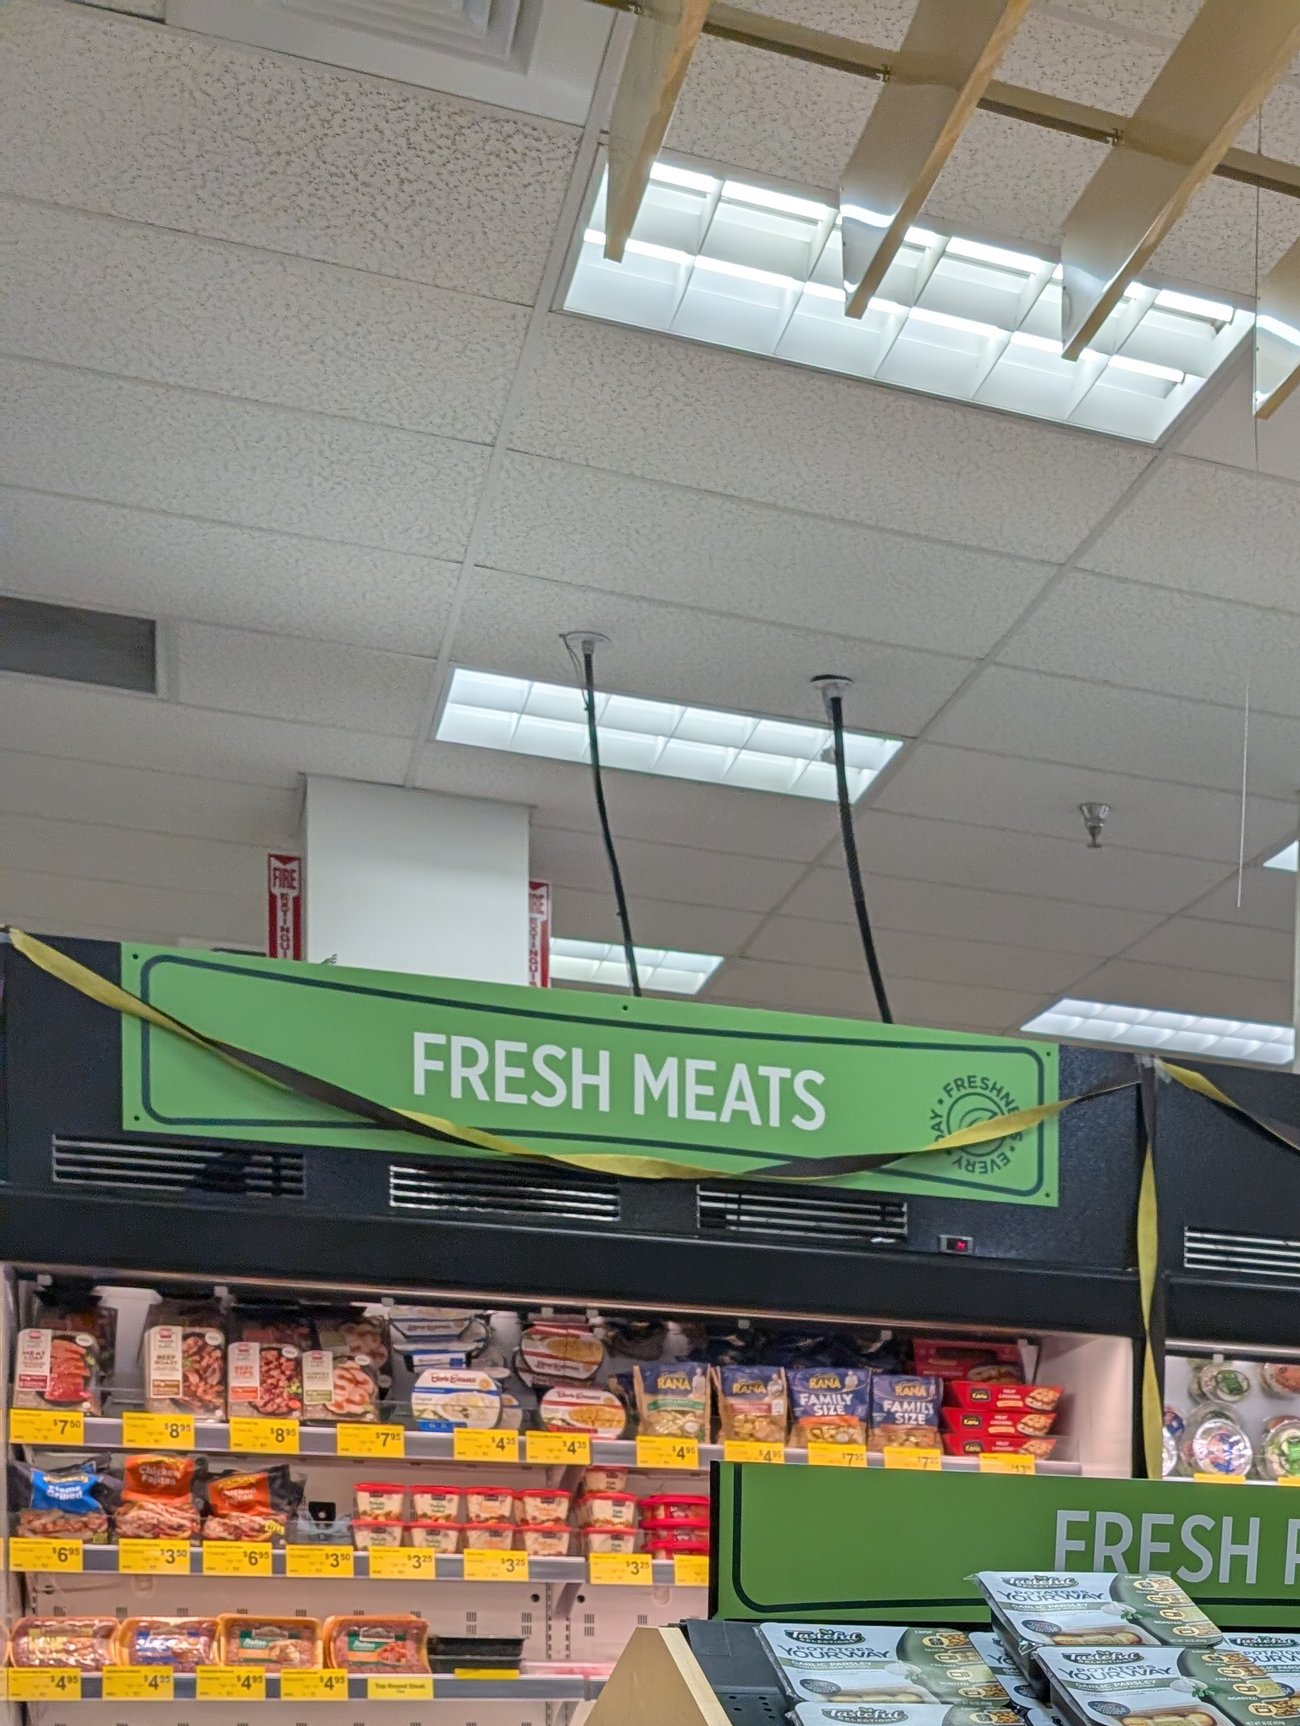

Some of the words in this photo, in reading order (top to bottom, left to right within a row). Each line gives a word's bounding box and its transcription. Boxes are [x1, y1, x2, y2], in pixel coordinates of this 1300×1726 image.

[272, 867, 298, 890] FIRE
[413, 1031, 610, 1113] FRESH
[633, 1053, 826, 1131] MEATS
[952, 1152, 1011, 1175] EVERY
[801, 1393, 853, 1404] FAMILY
[814, 1403, 846, 1416] SIZE
[883, 1400, 933, 1414] FAMILY
[895, 1412, 926, 1425] SIZE
[1054, 1510, 1261, 1584] FRESH
[1071, 1652, 1137, 1660] Tasteful
[830, 1709, 902, 1719] Tasteful
